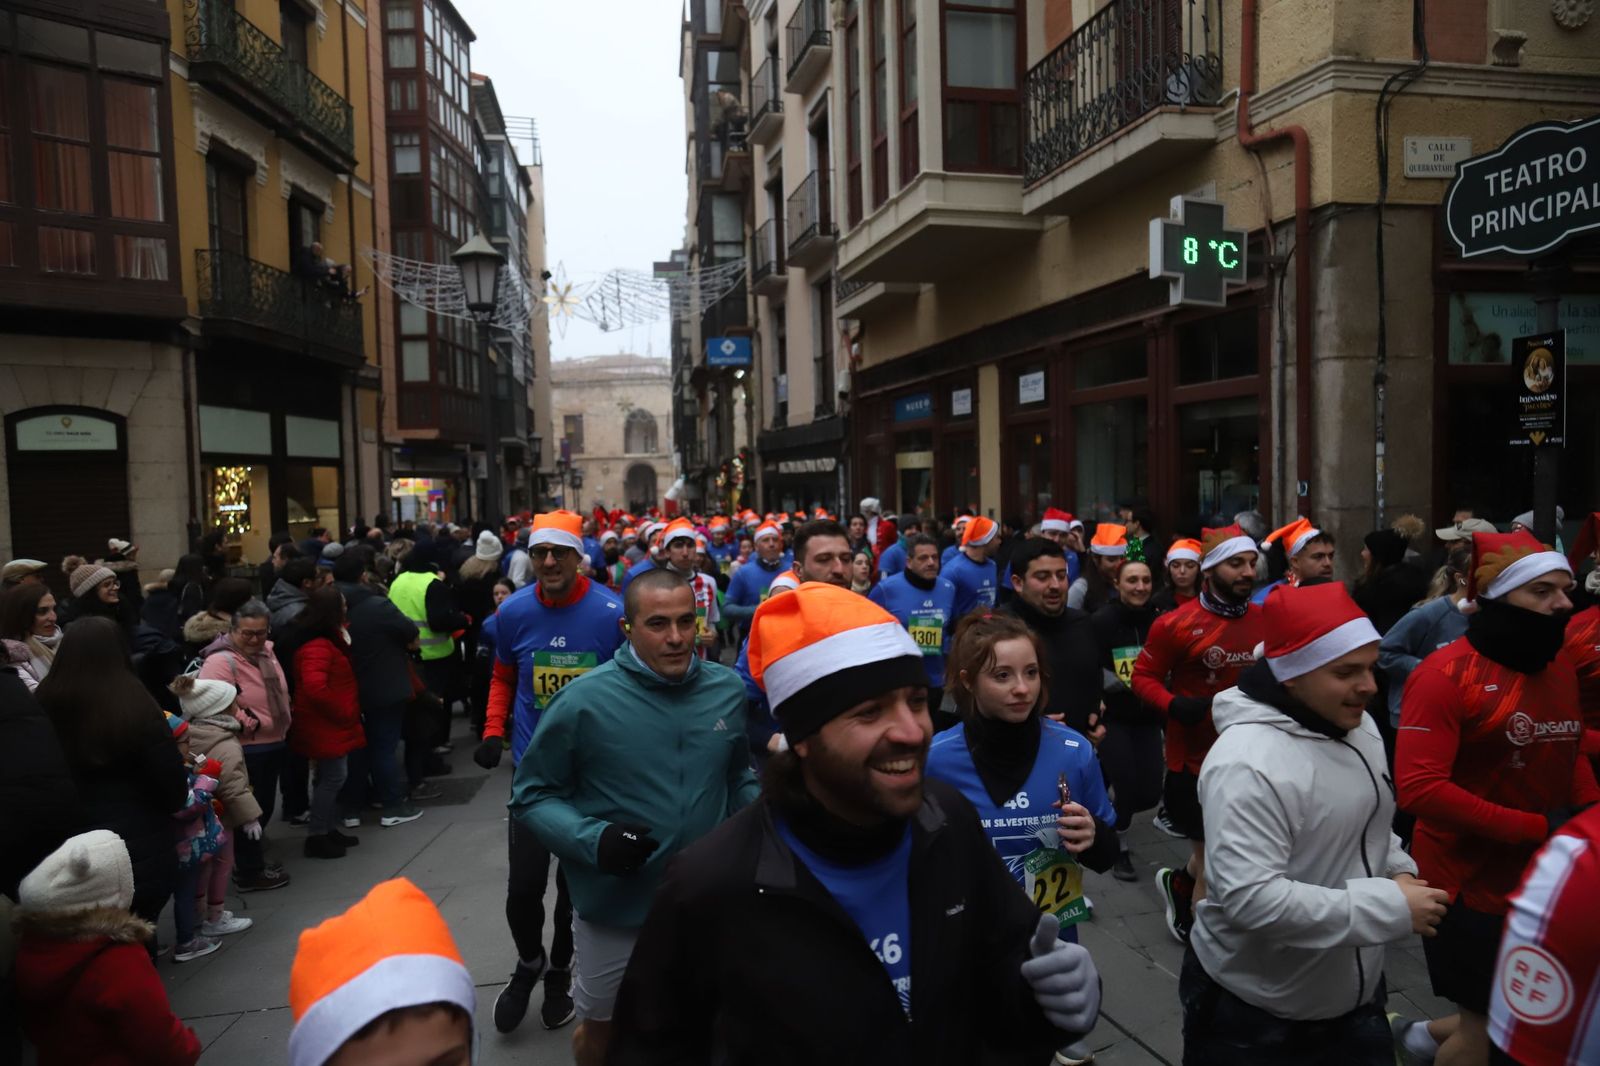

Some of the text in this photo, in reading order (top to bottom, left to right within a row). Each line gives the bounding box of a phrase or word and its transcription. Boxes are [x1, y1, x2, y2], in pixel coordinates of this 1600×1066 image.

[1428, 143, 1456, 152] CALLE
[1433, 154, 1445, 162] DE
[1484, 146, 1587, 197] TEATRO
[1471, 182, 1600, 238] PRINCIPAL
[1183, 237, 1198, 264] 8
[1510, 303, 1537, 317] aliad
[923, 599, 933, 608] 46
[550, 636, 566, 648] 46
[911, 629, 936, 645] 1301
[1119, 660, 1136, 678] 4
[1004, 791, 1029, 809] 46
[994, 816, 1039, 828] SILVESTRE
[1034, 867, 1069, 911] 22
